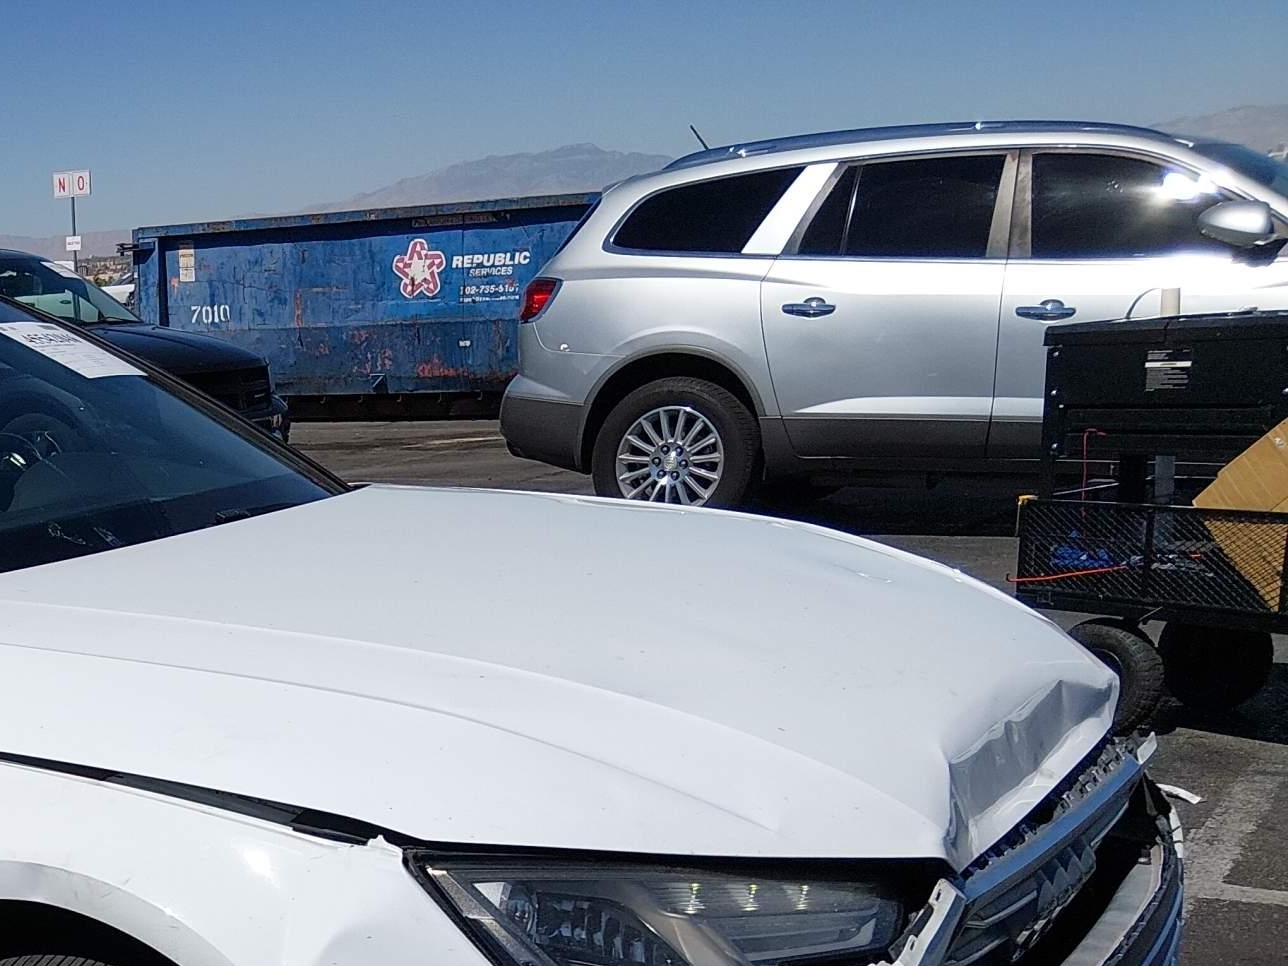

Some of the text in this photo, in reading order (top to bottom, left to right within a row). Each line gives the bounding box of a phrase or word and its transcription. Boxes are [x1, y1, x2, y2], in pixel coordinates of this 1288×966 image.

[452, 251, 531, 269] REPUBLIC
[469, 266, 514, 277] SERVICES
[190, 303, 231, 324] 7010
